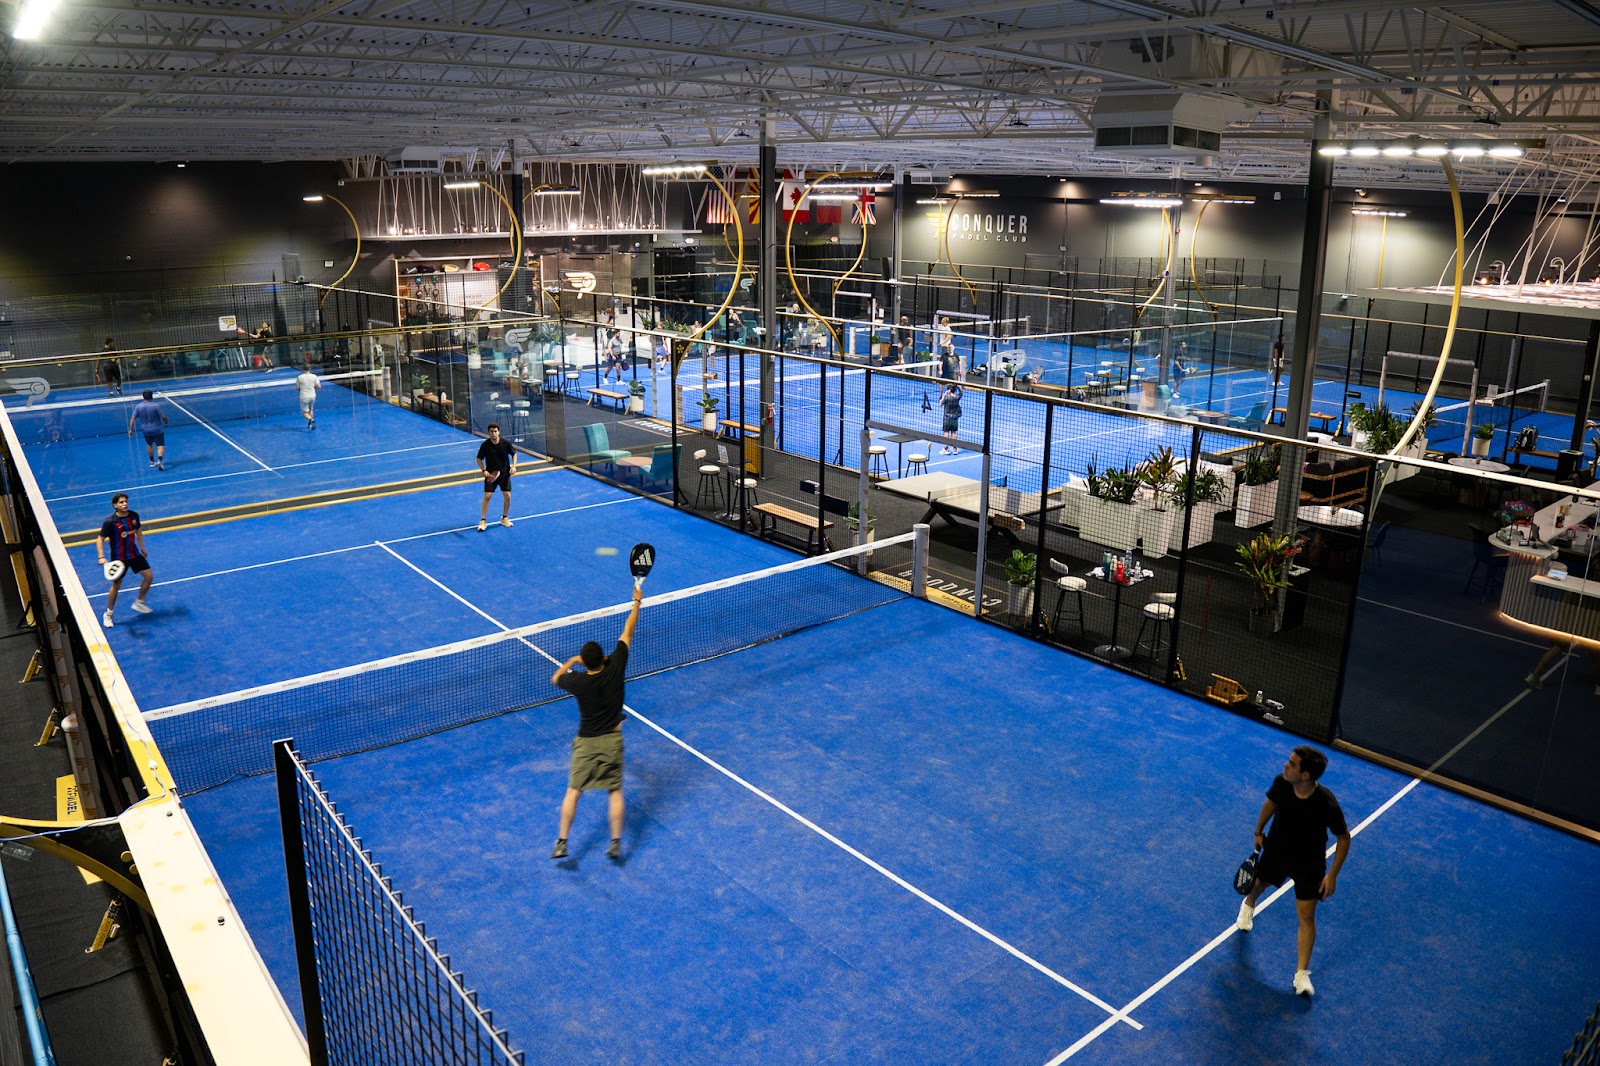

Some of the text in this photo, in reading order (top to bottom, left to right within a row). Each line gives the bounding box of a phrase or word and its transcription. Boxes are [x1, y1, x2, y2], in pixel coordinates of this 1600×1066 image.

[952, 213, 1028, 234] CONQUER
[953, 233, 1027, 243] PADEL CLUB
[898, 570, 1002, 607] CONQUR
